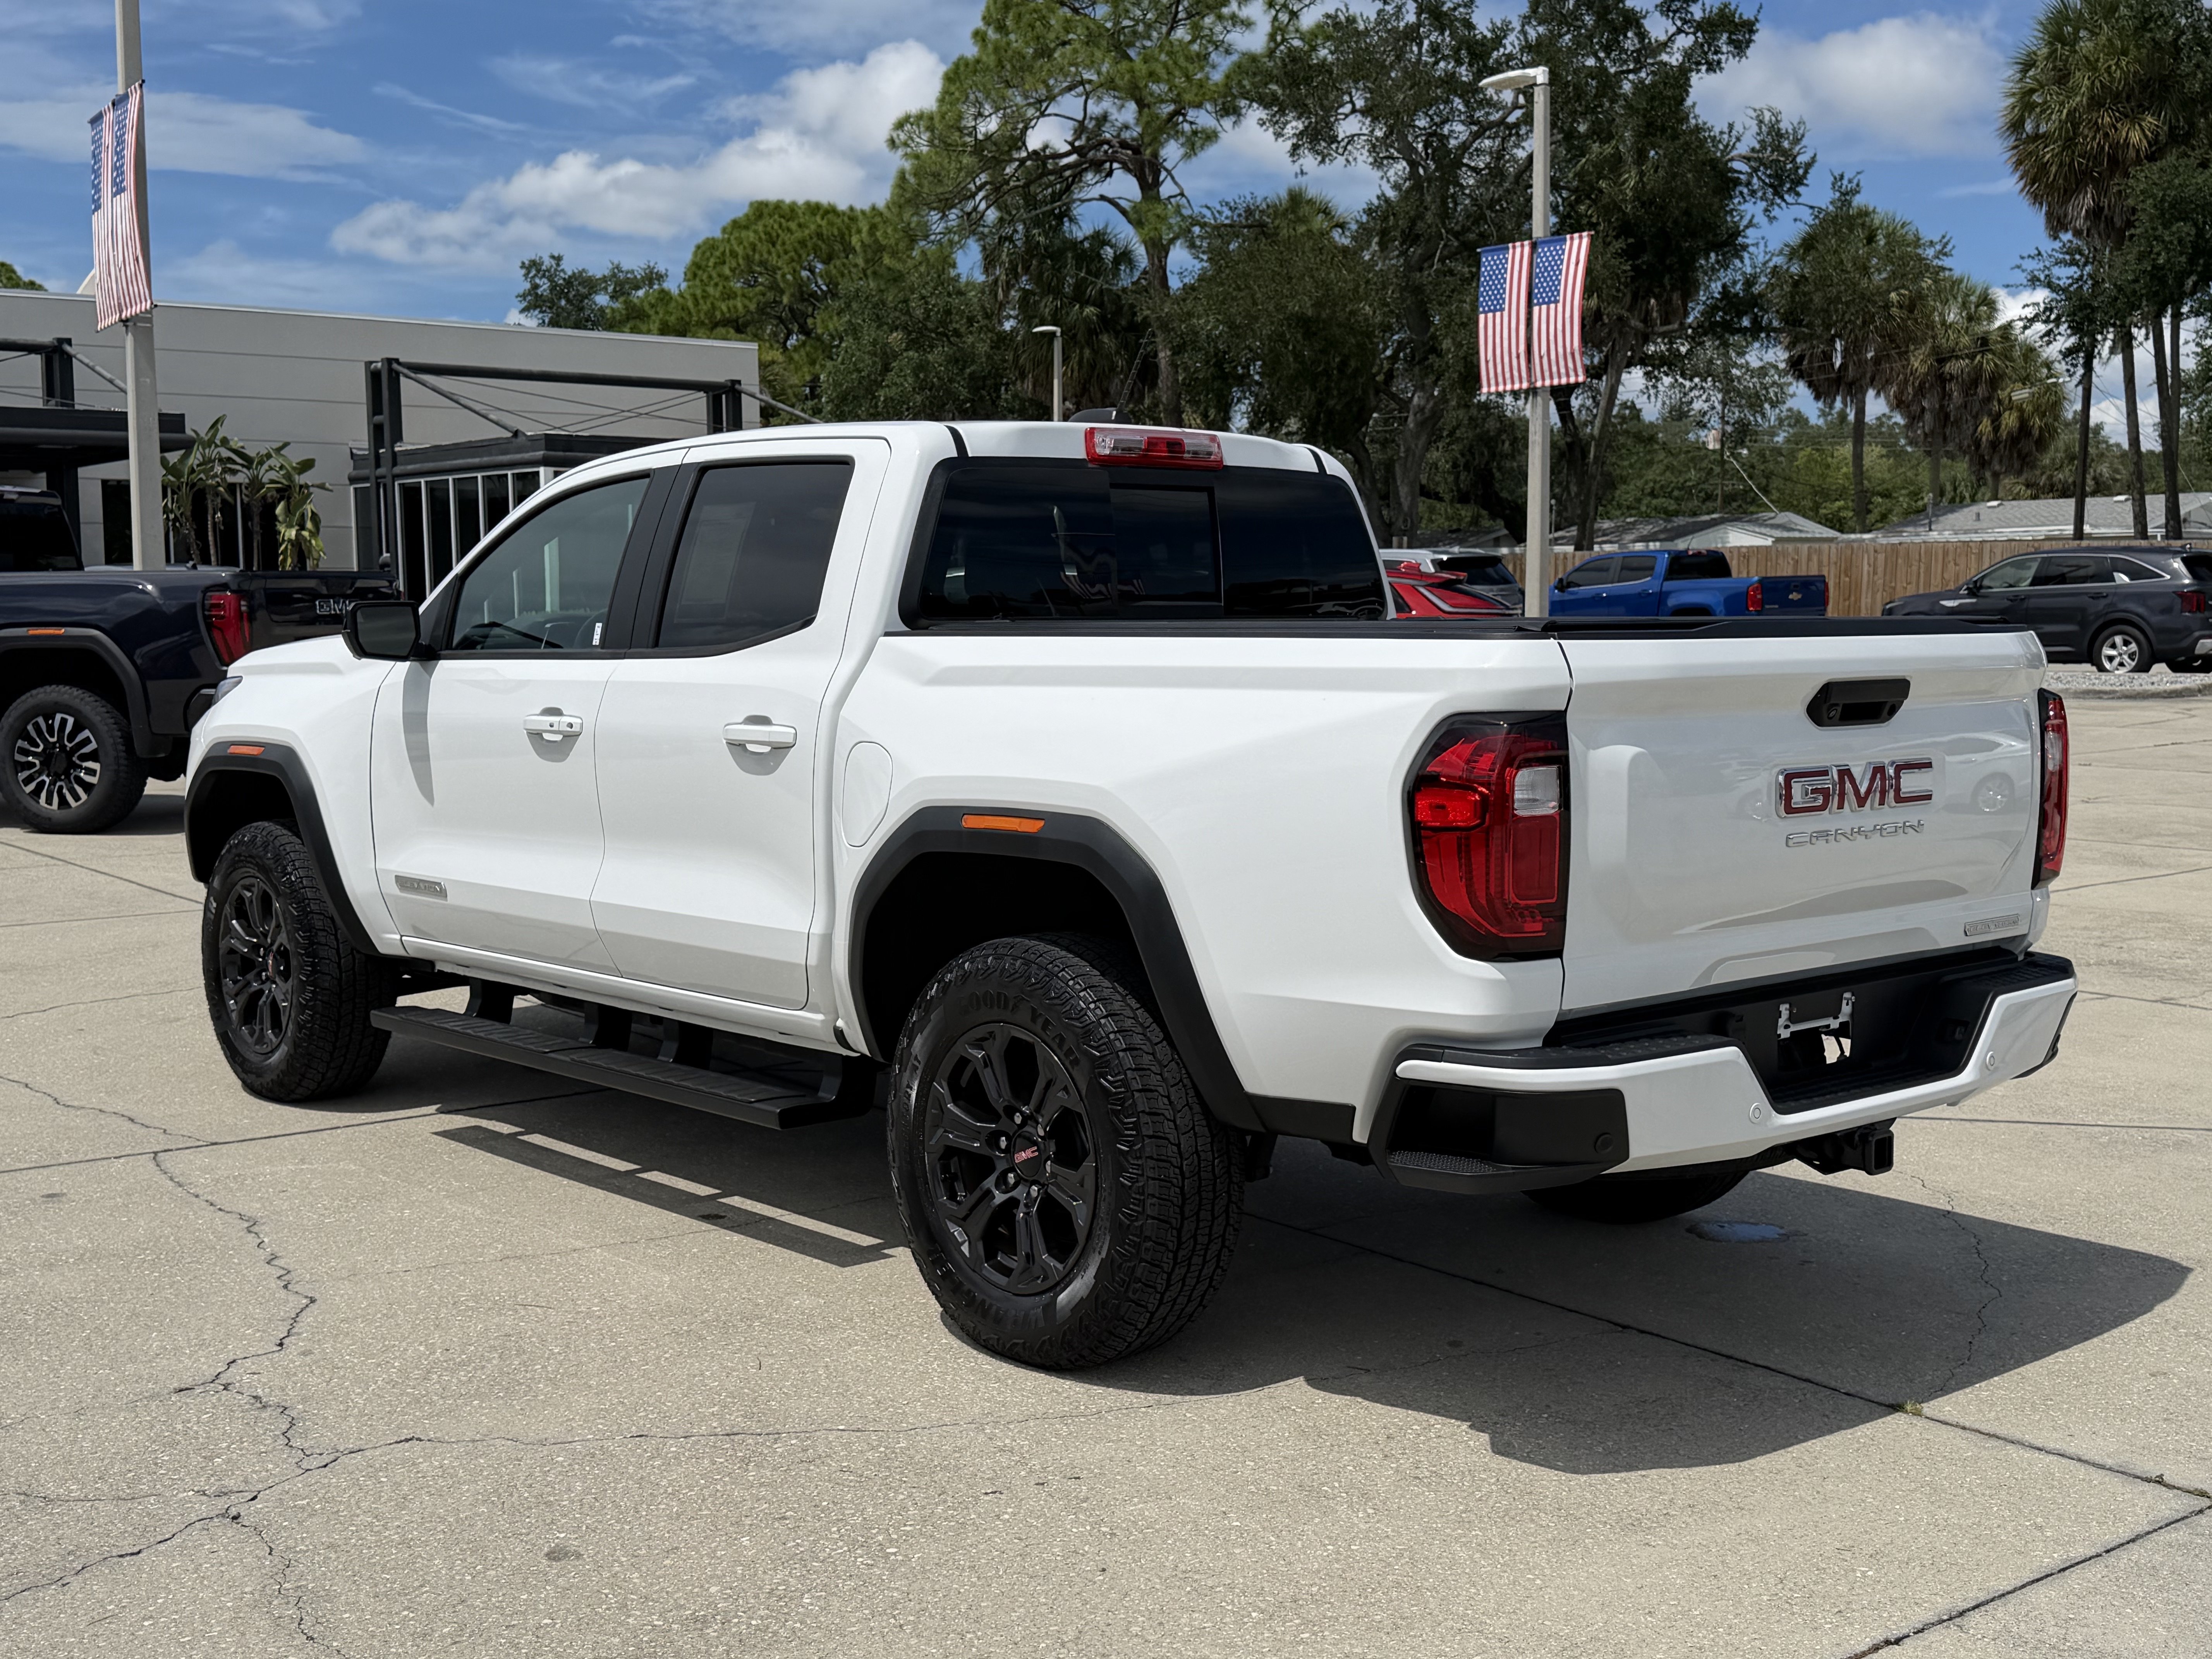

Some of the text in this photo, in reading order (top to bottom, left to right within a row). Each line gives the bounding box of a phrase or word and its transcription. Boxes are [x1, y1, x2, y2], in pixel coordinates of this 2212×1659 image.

[1776, 757, 1933, 818] GMC
[1786, 819, 1924, 847] CANYON
[1014, 1146, 1039, 1163] GMC
